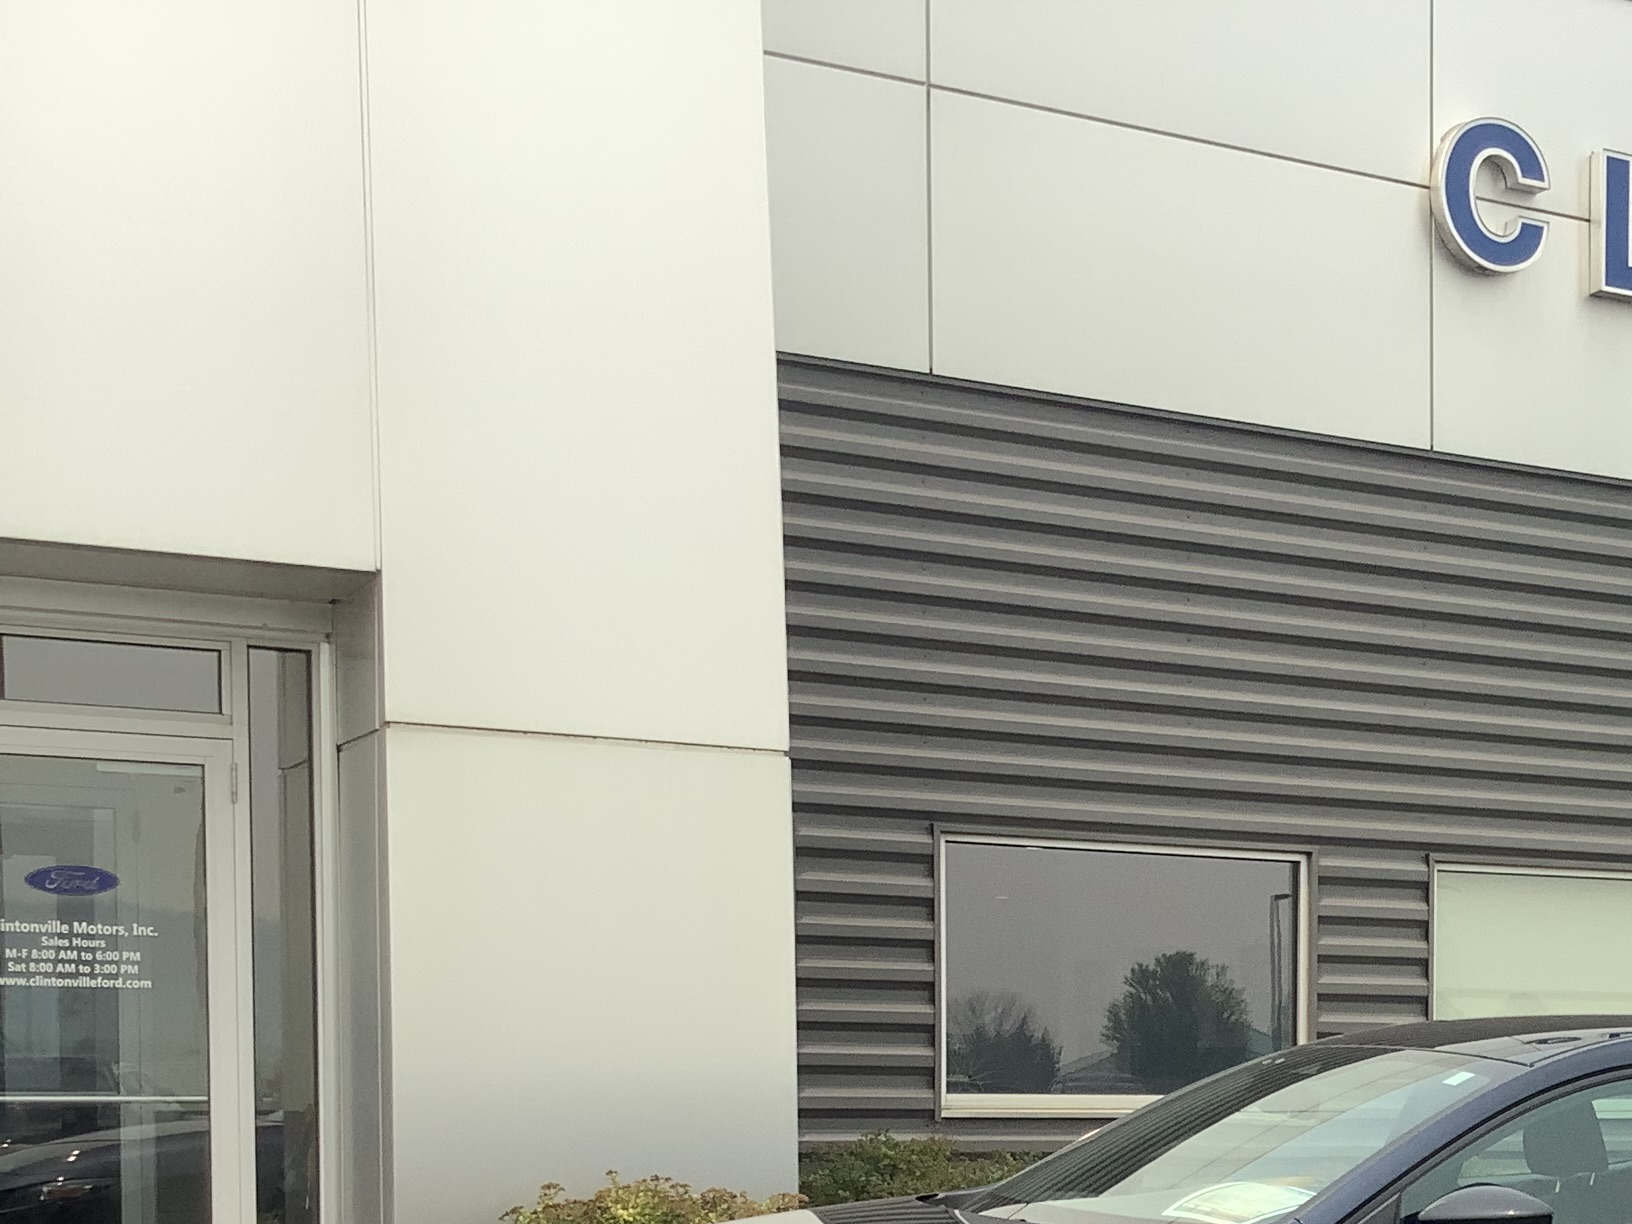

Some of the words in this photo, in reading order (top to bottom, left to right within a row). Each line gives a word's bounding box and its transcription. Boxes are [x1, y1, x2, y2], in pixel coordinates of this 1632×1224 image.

[73, 921, 129, 936] Motors,
[132, 923, 159, 937] Inc.
[41, 936, 70, 948] Sales
[72, 937, 106, 949] Hours
[5, 948, 28, 959] M-F
[31, 948, 56, 960] 8:00
[58, 949, 78, 960] AM
[81, 950, 93, 961] to
[95, 950, 120, 962] 6:00
[122, 951, 142, 962] PM
[7, 961, 27, 973] Sat
[29, 962, 53, 973] 8:00
[56, 963, 76, 974] AM
[78, 963, 91, 974] to
[93, 964, 118, 974] 3:00
[120, 965, 139, 975] PM
[0, 975, 153, 989] www.clintonvilleford.com
